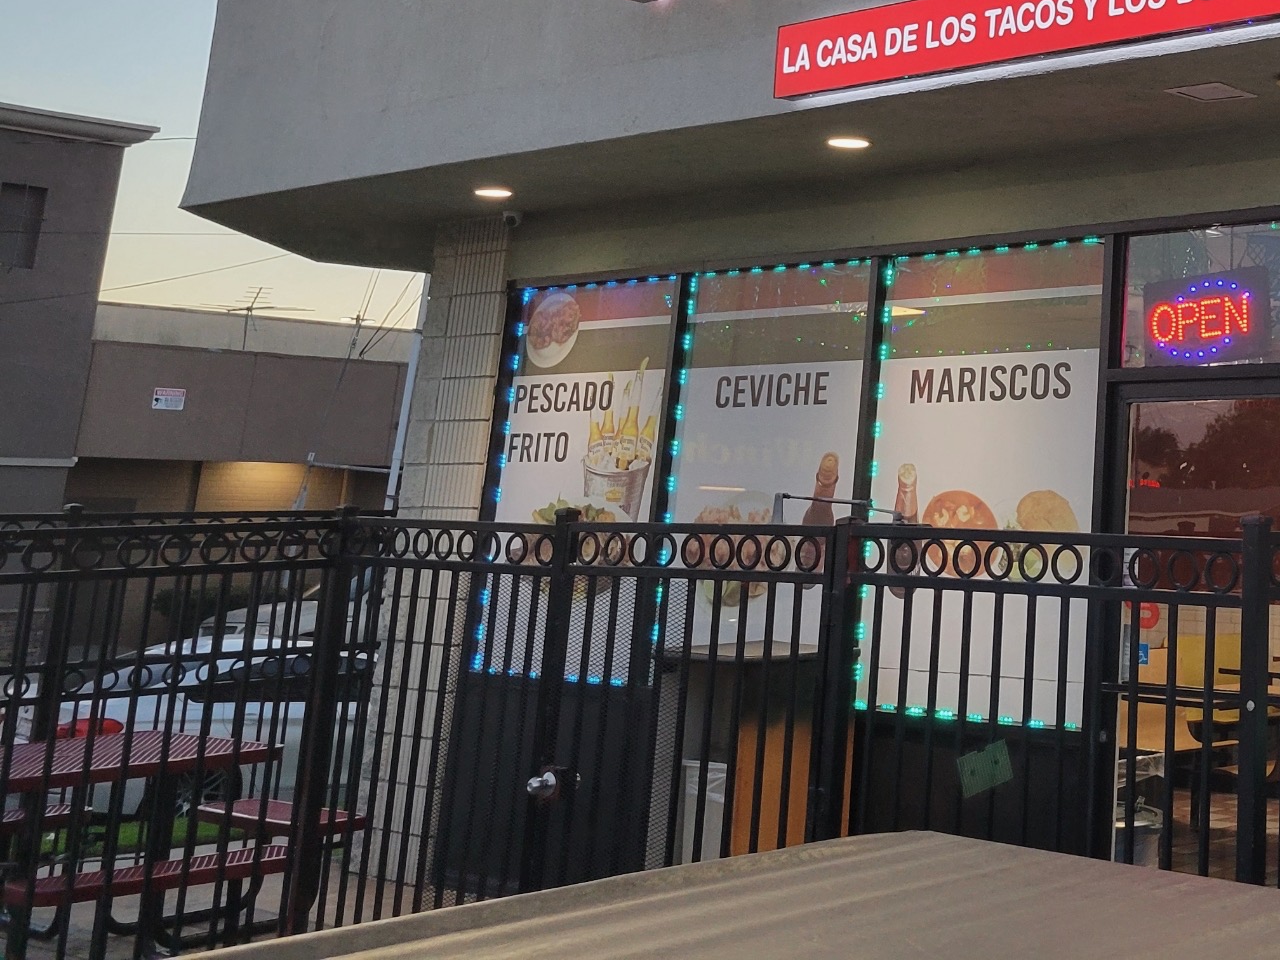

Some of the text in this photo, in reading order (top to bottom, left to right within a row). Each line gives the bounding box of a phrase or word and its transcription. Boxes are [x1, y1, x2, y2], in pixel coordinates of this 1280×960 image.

[782, 45, 811, 74] LA
[816, 31, 878, 68] CASA
[884, 23, 919, 56] DE
[925, 12, 976, 49] LOS
[1151, 294, 1249, 342] OPEN
[513, 380, 615, 414] PESCADO
[715, 371, 830, 409] CEVICHE
[909, 361, 1072, 404] MARISCOS
[507, 431, 570, 463] FRITO
